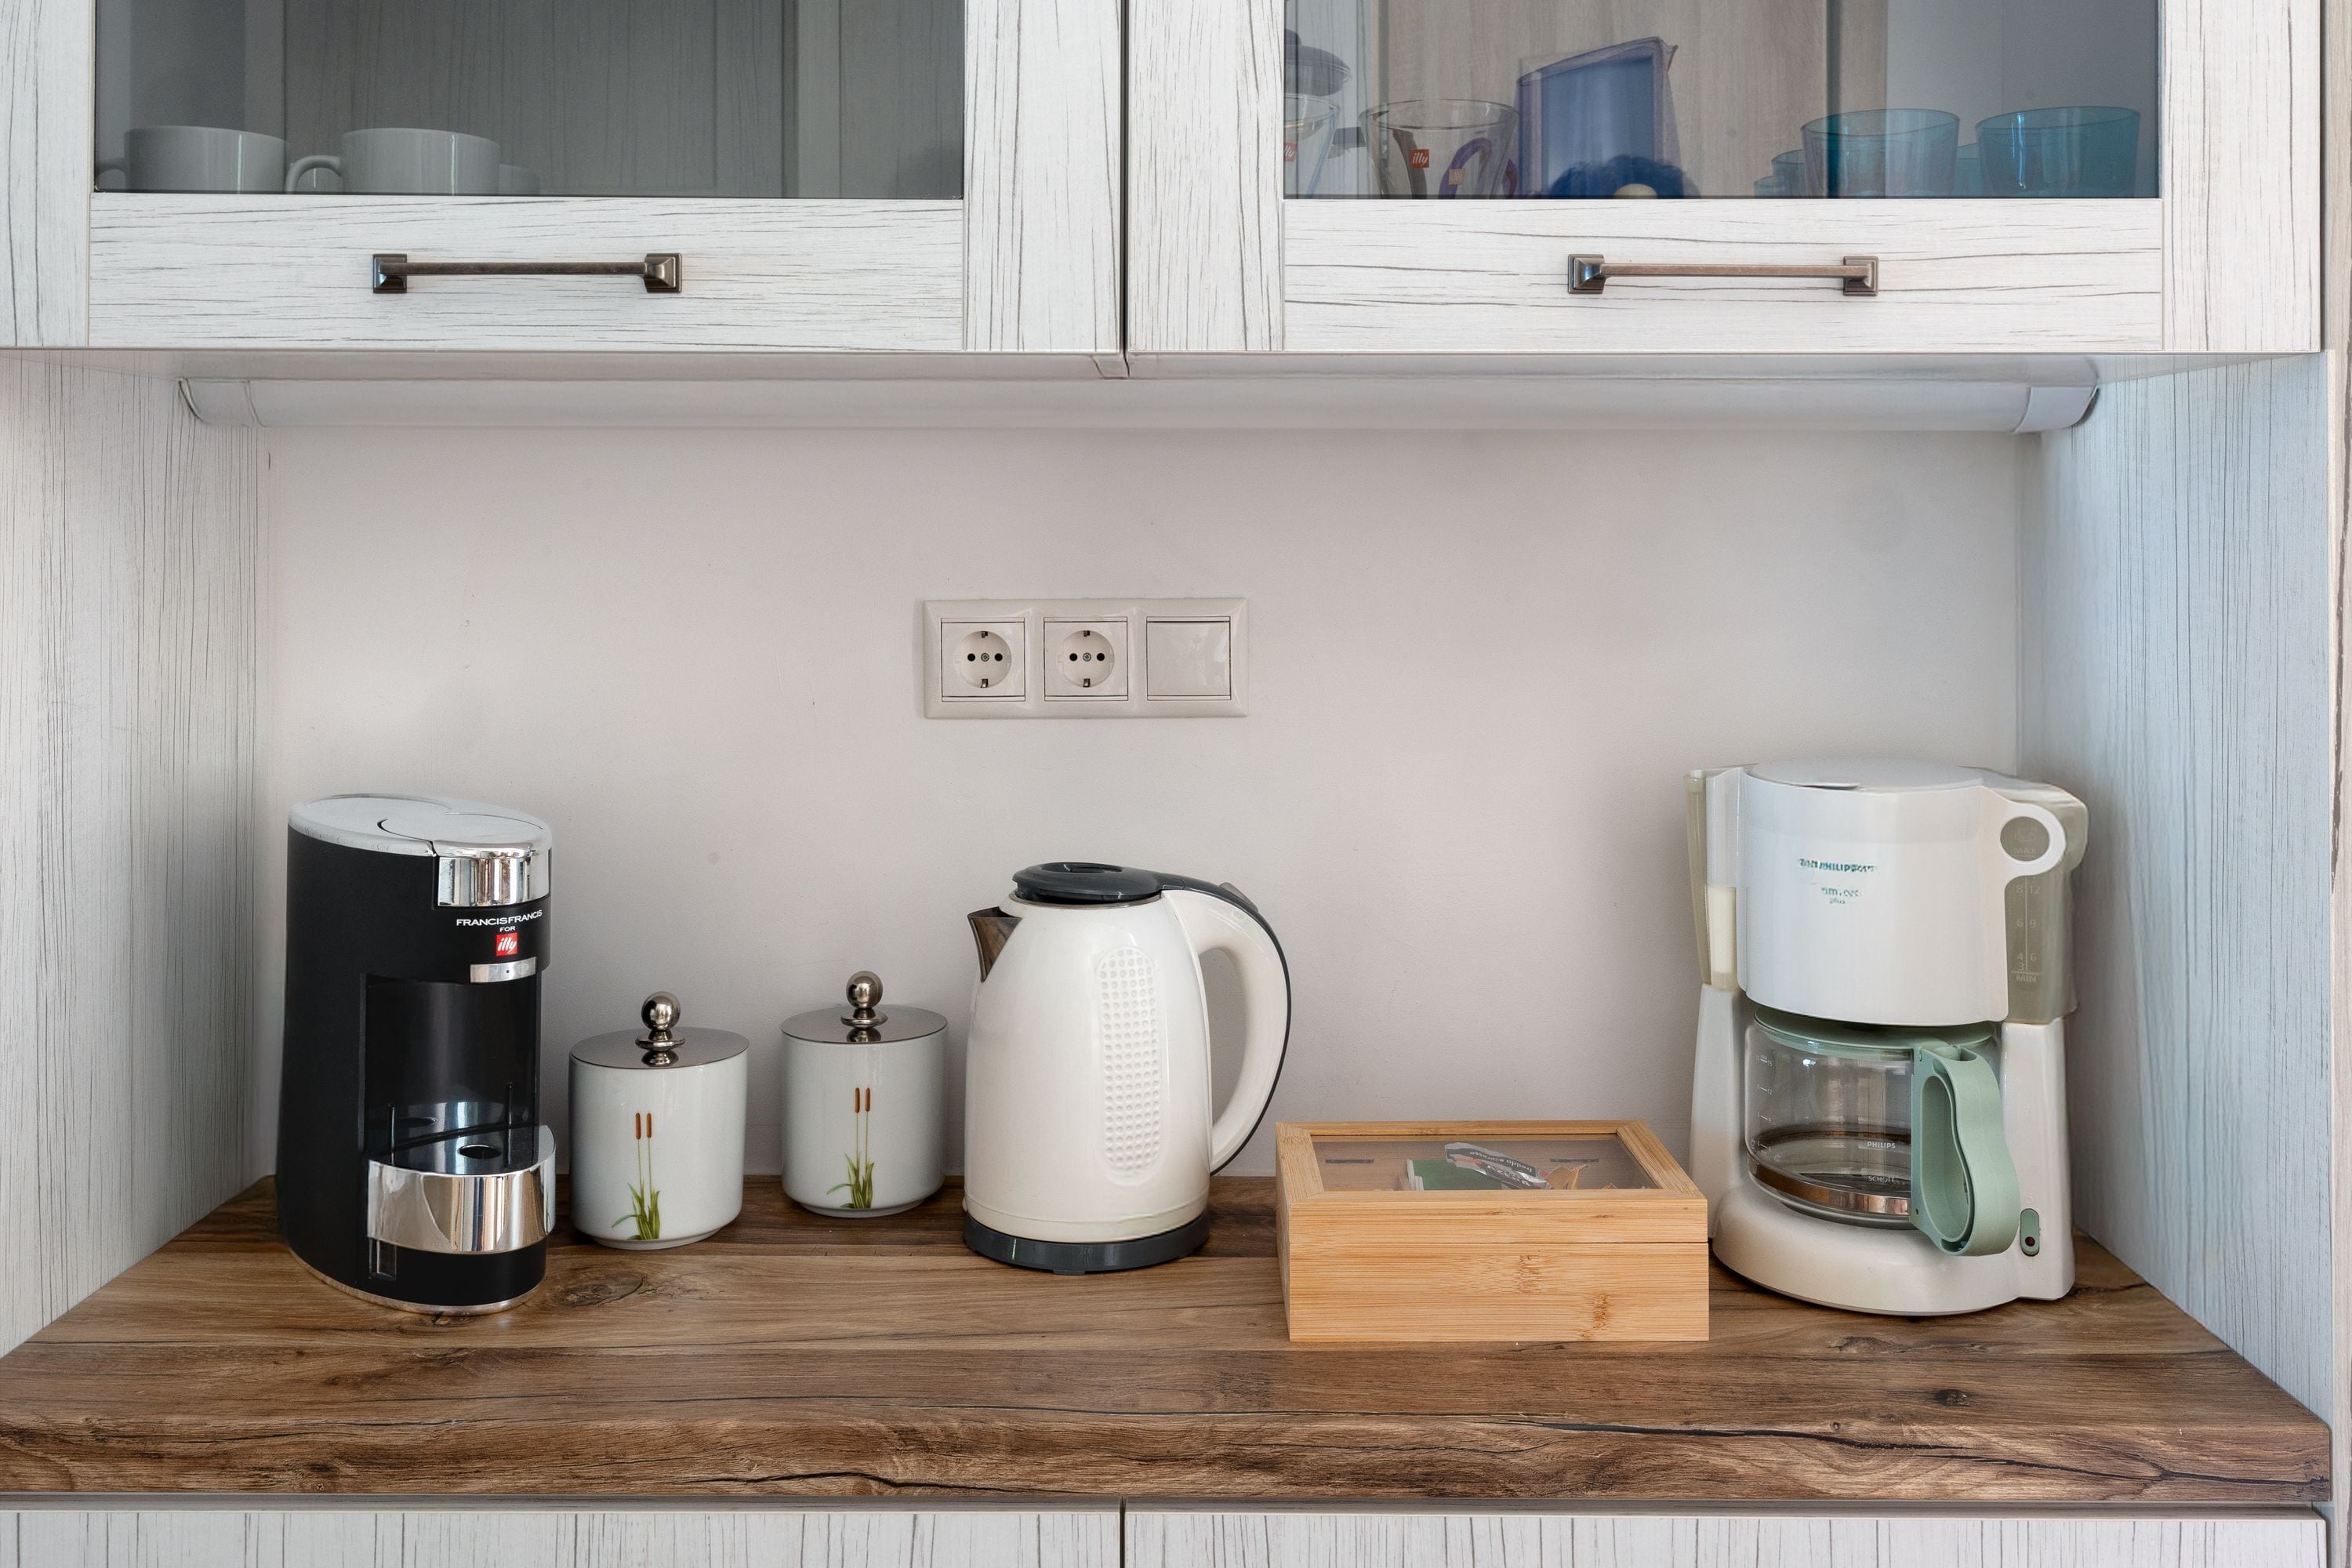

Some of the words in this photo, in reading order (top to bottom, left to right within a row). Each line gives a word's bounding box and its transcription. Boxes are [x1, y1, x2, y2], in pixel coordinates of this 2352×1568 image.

[1412, 151, 1428, 167] illy
[2029, 885, 2040, 895] 12
[456, 909, 543, 927] FRANCISFRANCIS
[2029, 919, 2037, 928] 9
[497, 936, 517, 953] illy
[2029, 953, 2037, 962] 6
[2016, 975, 2037, 983] MIN
[1867, 1141, 1896, 1149] PHILIPS
[1867, 1174, 1895, 1184] SCHOTT
